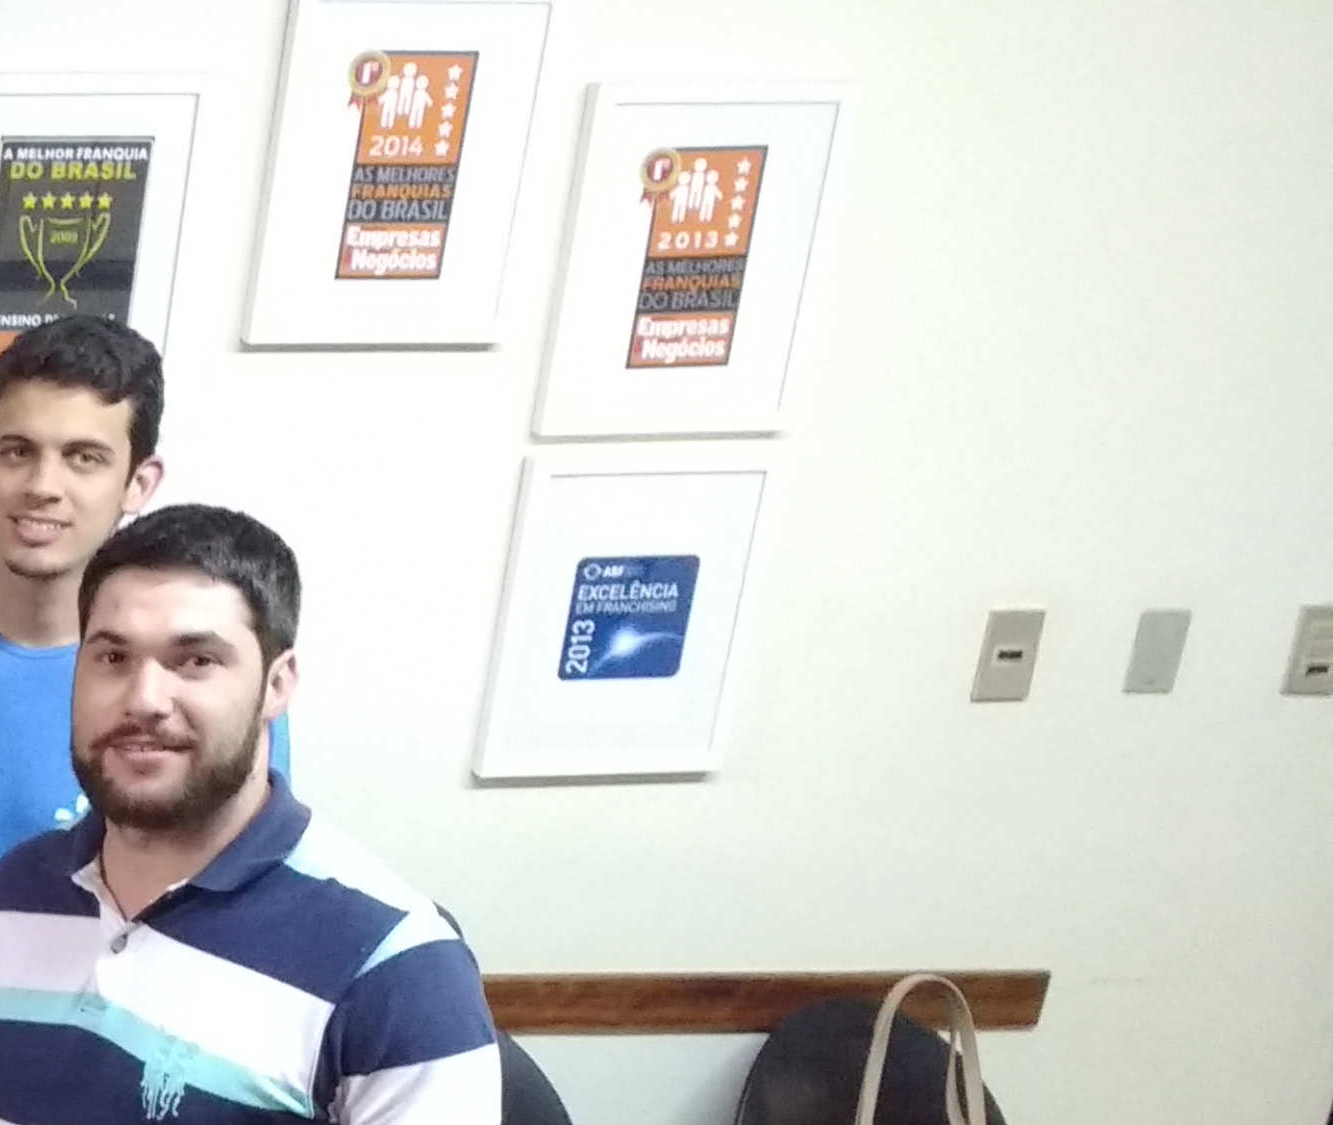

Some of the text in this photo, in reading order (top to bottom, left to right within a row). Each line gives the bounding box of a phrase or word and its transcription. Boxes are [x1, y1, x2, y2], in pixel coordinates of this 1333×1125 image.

[3, 147, 149, 160] A MELHOR FRANQUIA
[369, 134, 424, 157] 2014
[9, 161, 137, 180] DO BRASIL
[354, 165, 455, 183] AS MELHORES
[351, 183, 452, 199] FRANQUIAS
[347, 199, 448, 221] DO BRASIL
[346, 225, 441, 249] Empresas
[657, 229, 720, 251] 2013
[349, 247, 438, 276] Negócios
[643, 272, 742, 291] FRANQUIAS
[639, 289, 737, 310] DO BRASIL
[637, 316, 730, 339] Empresas
[641, 337, 726, 363] Negócios
[577, 579, 679, 601] EXCELÊNCIA
[565, 618, 595, 674] 2013
